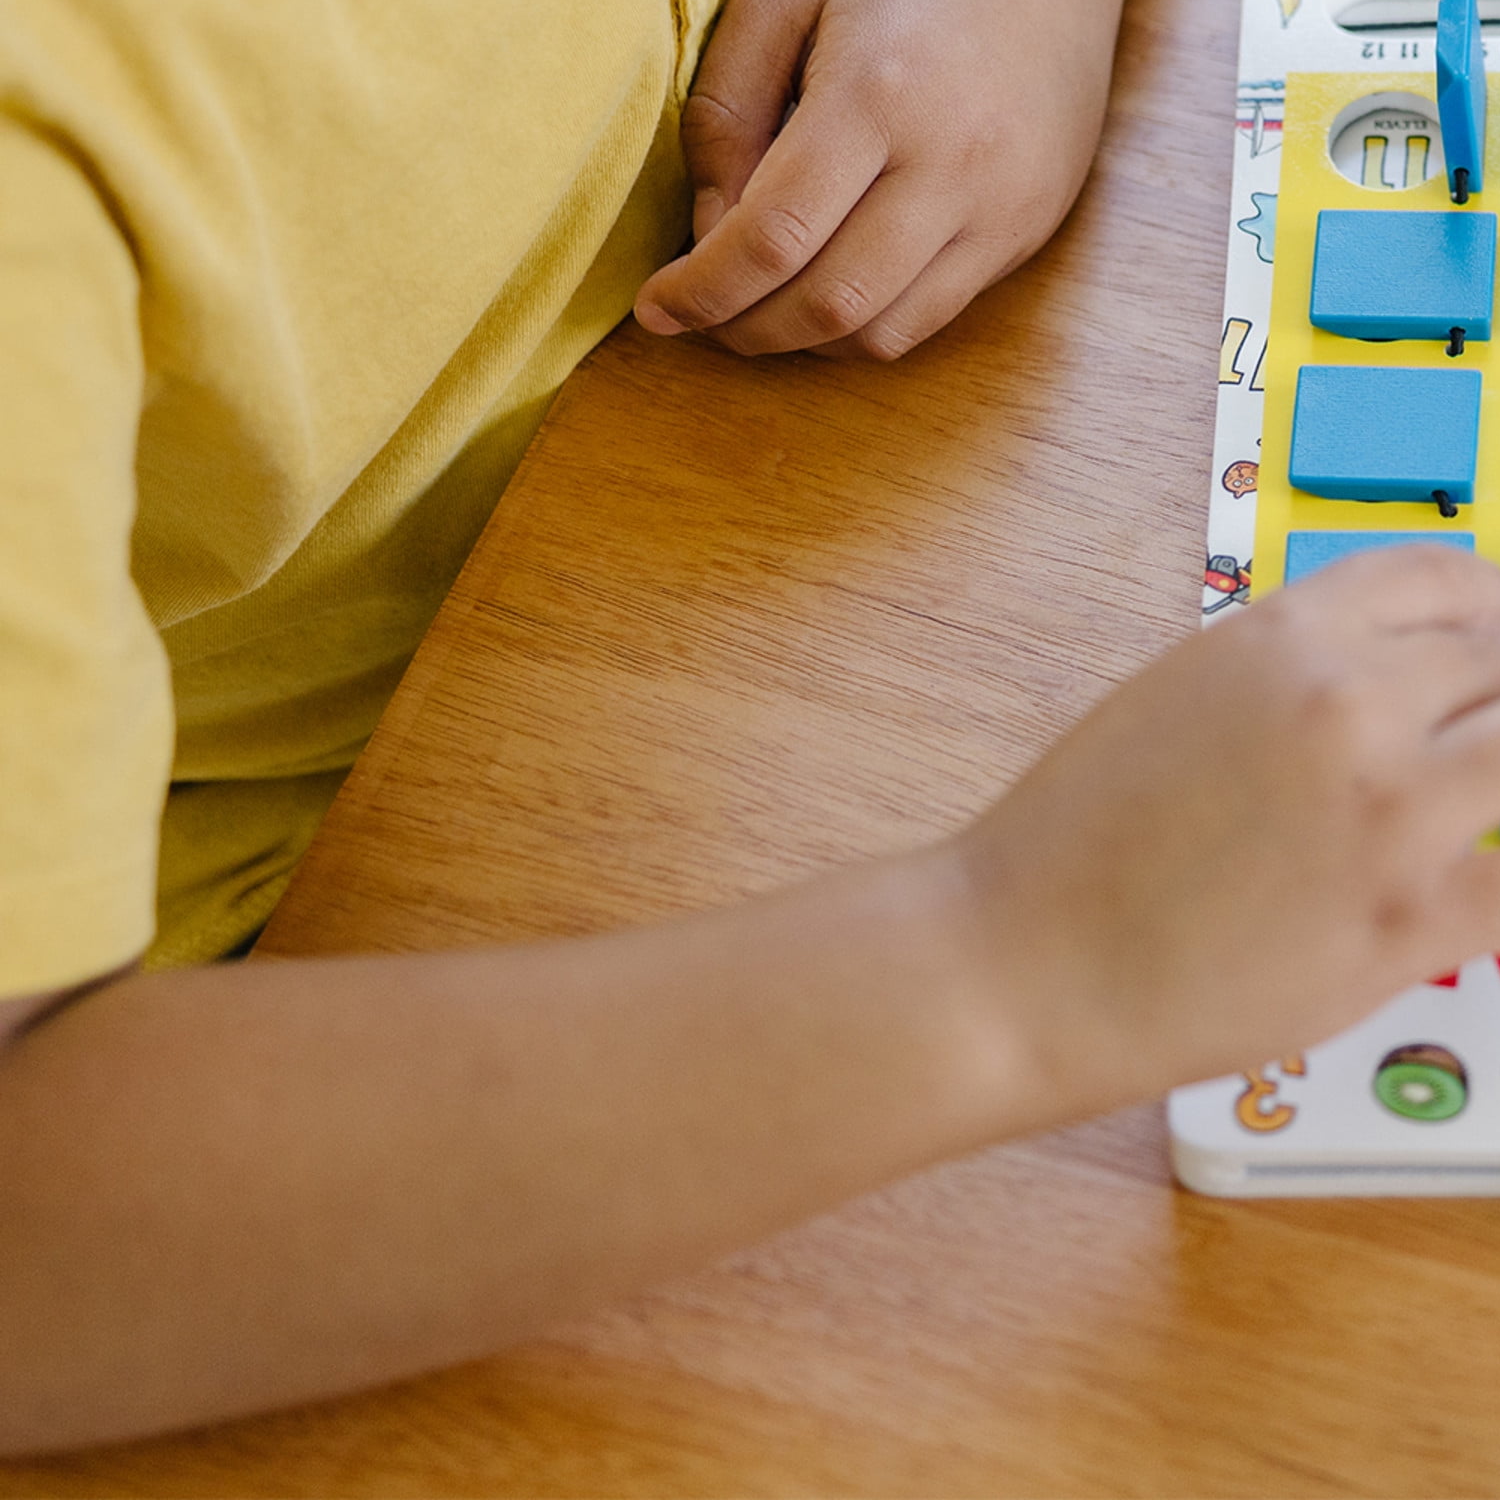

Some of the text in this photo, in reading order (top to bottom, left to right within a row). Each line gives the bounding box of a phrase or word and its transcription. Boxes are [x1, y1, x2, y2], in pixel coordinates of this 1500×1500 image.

[1360, 41, 1386, 61] 12
[1399, 41, 1420, 61] 11
[1373, 119, 1429, 131] ELEVEN
[1361, 134, 1431, 190] 11
